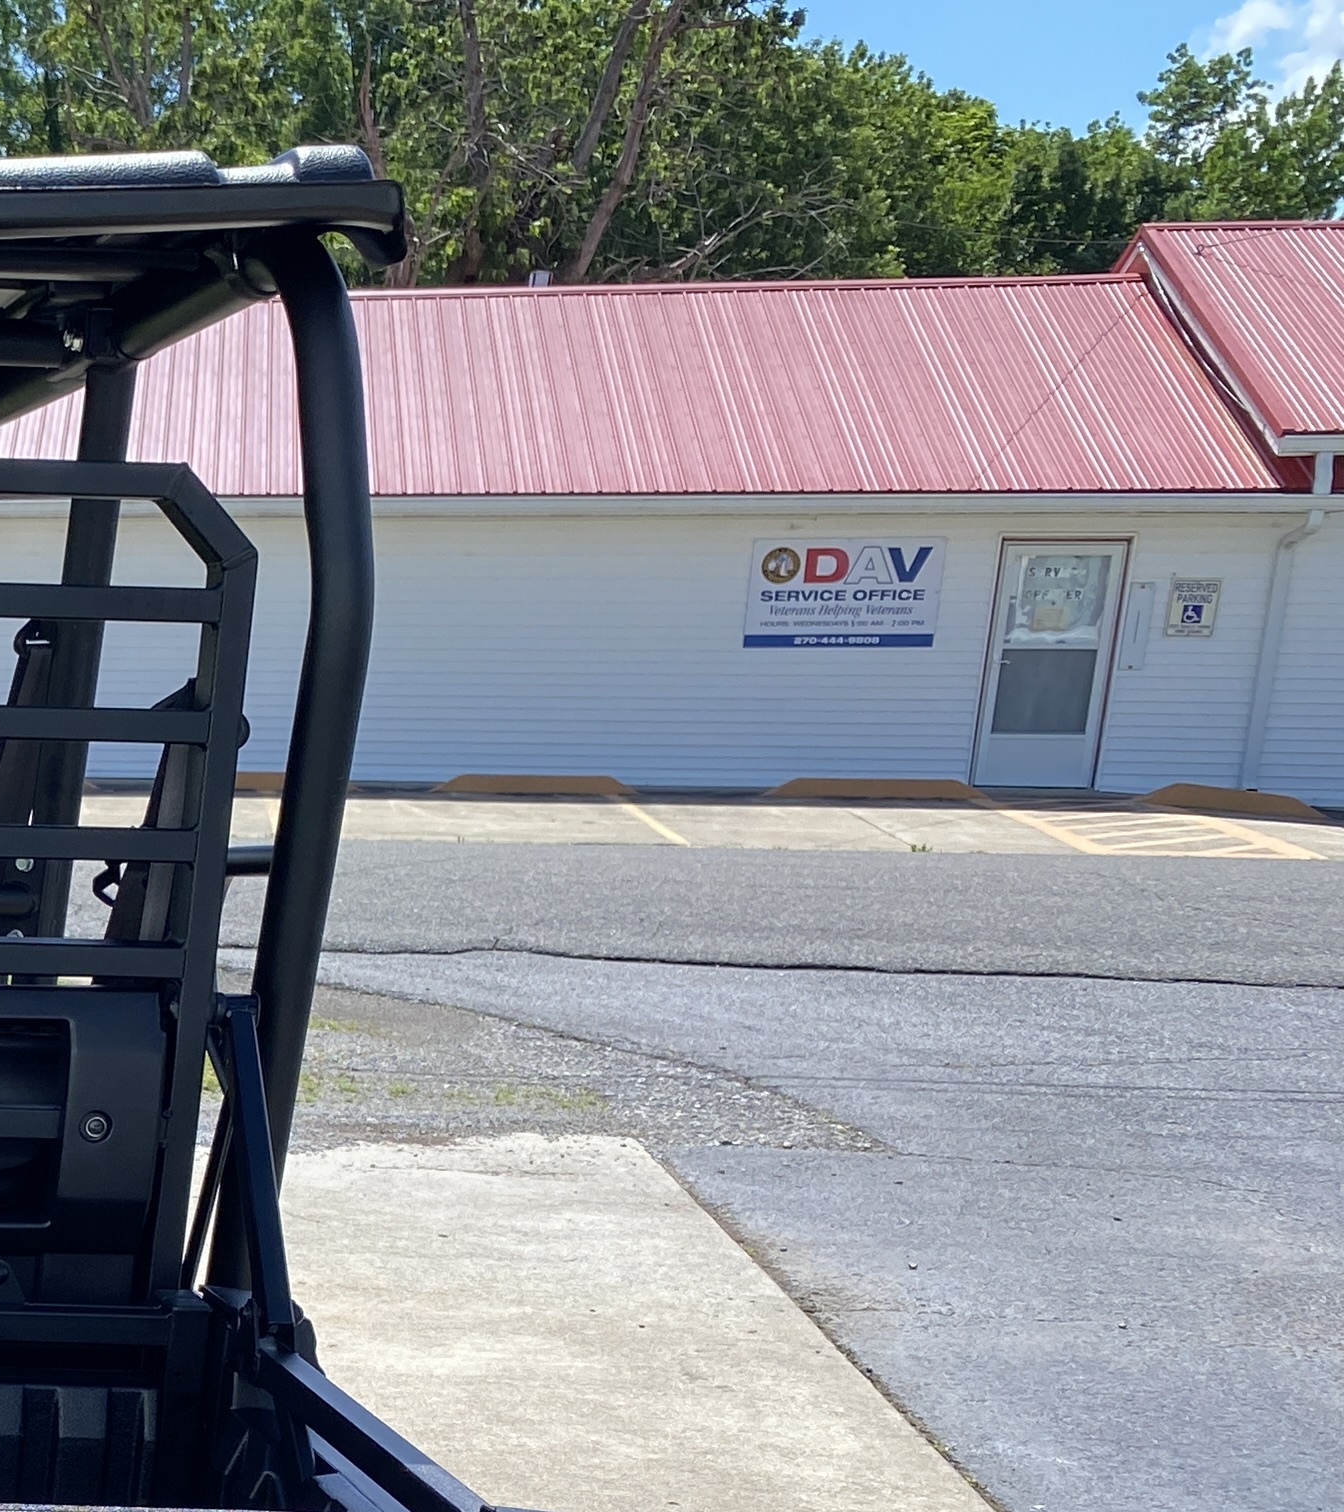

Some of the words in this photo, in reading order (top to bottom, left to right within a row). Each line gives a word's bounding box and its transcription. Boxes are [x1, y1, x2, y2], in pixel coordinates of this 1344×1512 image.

[803, 546, 933, 585] DAV
[1175, 582, 1218, 593] RESERVED
[760, 590, 847, 602] SERVICE
[852, 589, 926, 601] OFFICE
[1176, 593, 1213, 604] PARKING
[769, 604, 816, 617] Veterans
[819, 604, 863, 619] Helping
[865, 604, 914, 616] Veterans
